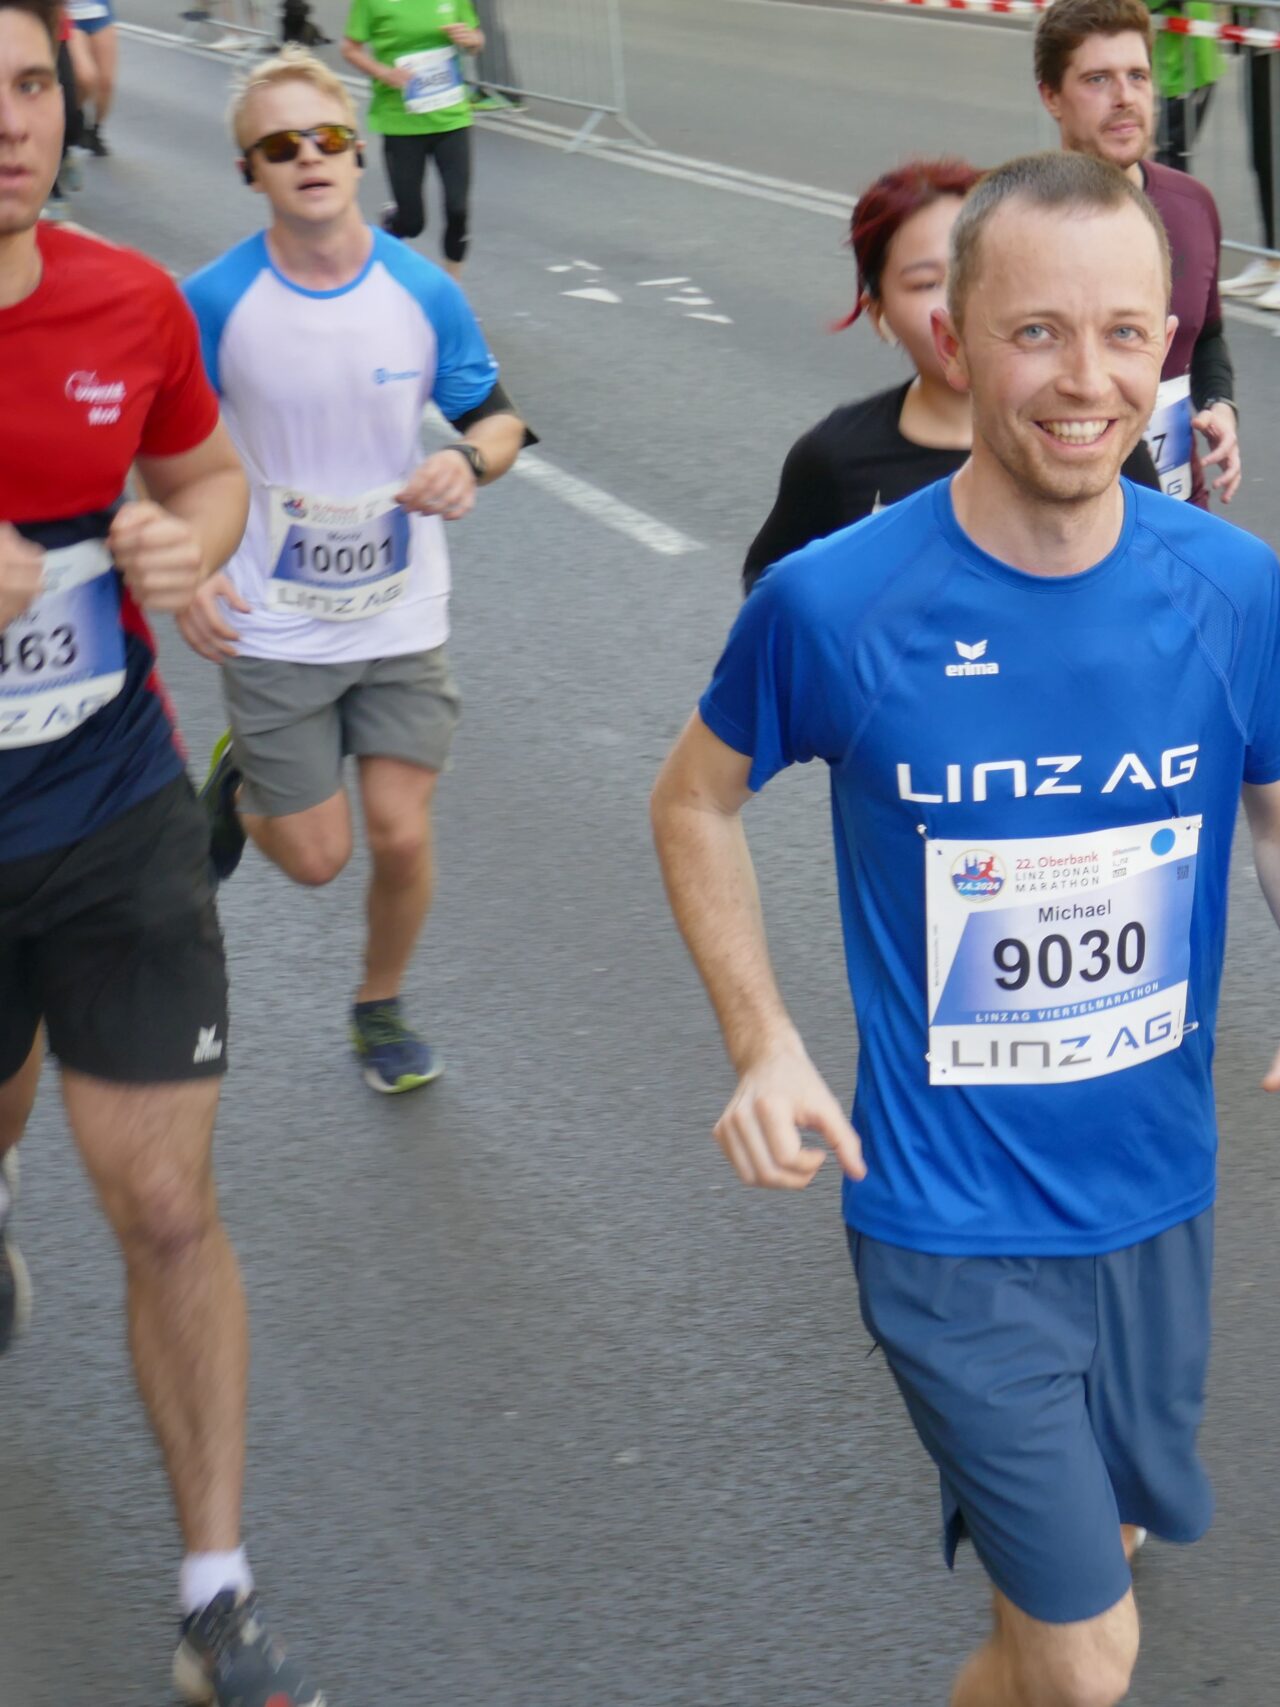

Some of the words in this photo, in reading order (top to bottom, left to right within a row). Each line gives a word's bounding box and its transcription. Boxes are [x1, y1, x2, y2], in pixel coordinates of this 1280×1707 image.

[291, 536, 393, 574] 10001
[945, 661, 999, 677] erima
[896, 754, 1083, 804] LINZ
[1100, 743, 1199, 794] AG
[1015, 858, 1035, 870] 22.
[1038, 851, 1099, 869] Oberbank
[1015, 869, 1046, 882] LINZ
[1052, 864, 1100, 880] DONAU
[1015, 876, 1101, 893] MARATHON
[1038, 899, 1111, 924] Michael
[992, 921, 1147, 991] 9030
[1038, 981, 1160, 1019] VIERTELMARATHON
[951, 1034, 1092, 1068] LINZ
[1106, 1011, 1172, 1058] AG
